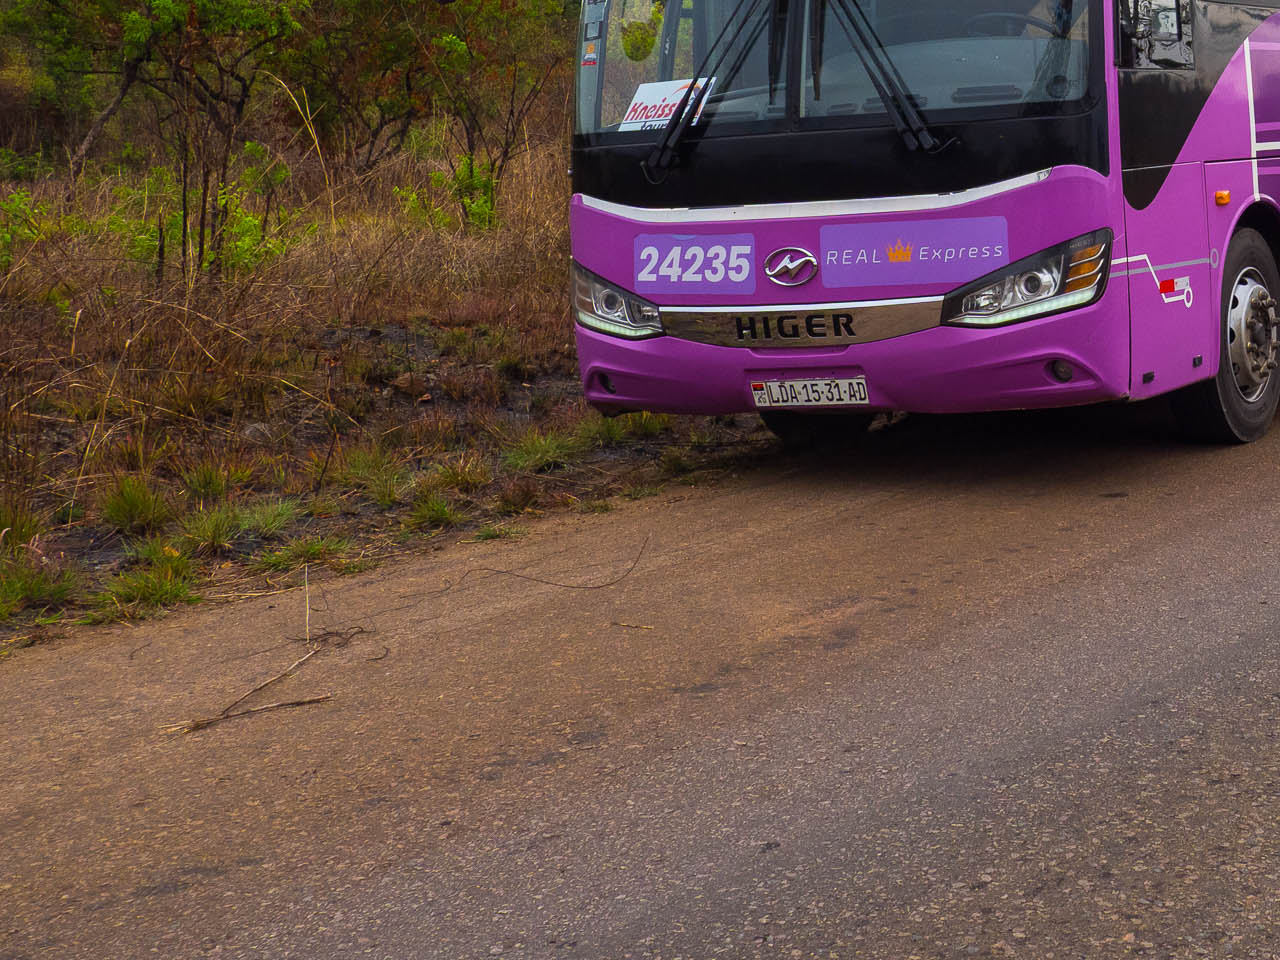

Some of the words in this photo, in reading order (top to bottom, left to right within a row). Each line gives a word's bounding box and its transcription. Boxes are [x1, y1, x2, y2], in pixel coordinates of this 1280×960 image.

[625, 97, 682, 121] Kneiss
[638, 245, 751, 282] 24235
[827, 250, 881, 264] REAL
[919, 244, 1003, 262] Express
[735, 313, 856, 339] HIGER
